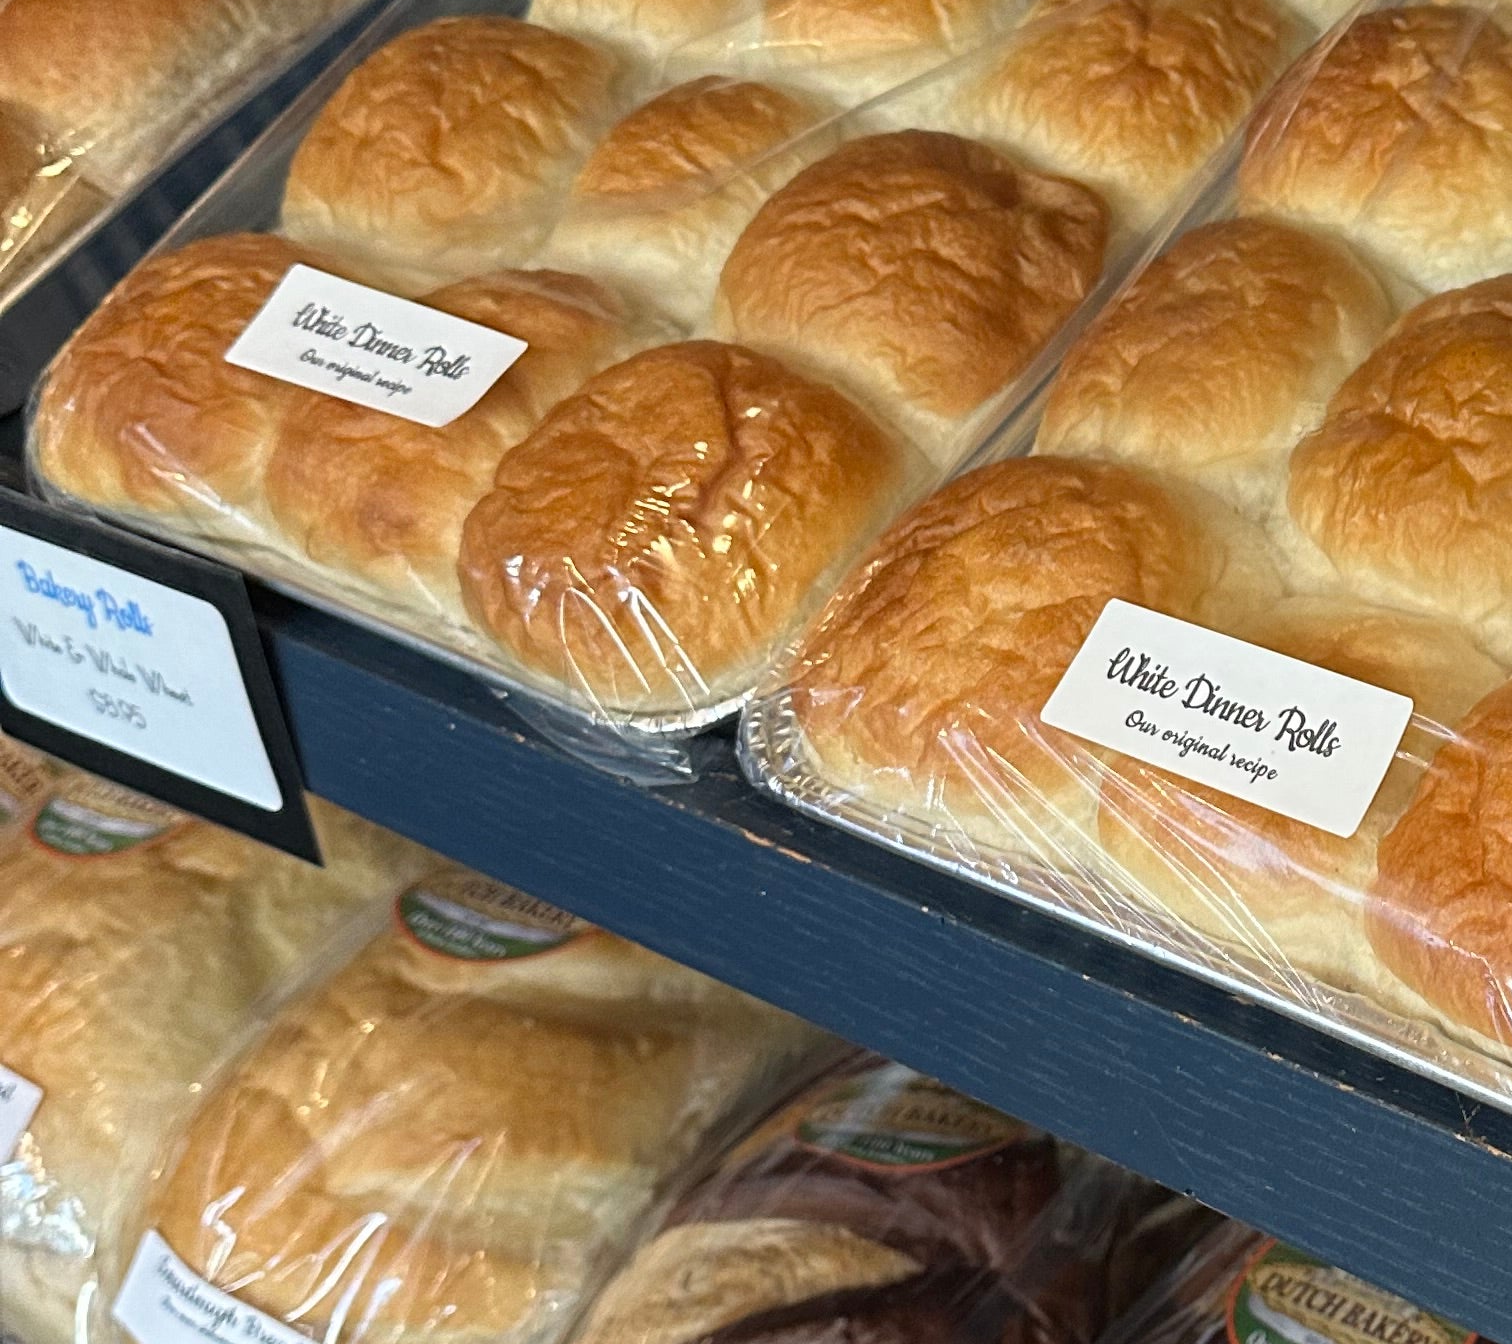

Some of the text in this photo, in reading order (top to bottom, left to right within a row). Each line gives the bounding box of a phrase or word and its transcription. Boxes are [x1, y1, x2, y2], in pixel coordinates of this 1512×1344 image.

[292, 302, 472, 381] White Dinner Rolls
[1106, 647, 1341, 759] White Dinner Rolls
[1125, 709, 1278, 784] Our original recipe
[1260, 1272, 1347, 1320] DUTCH
